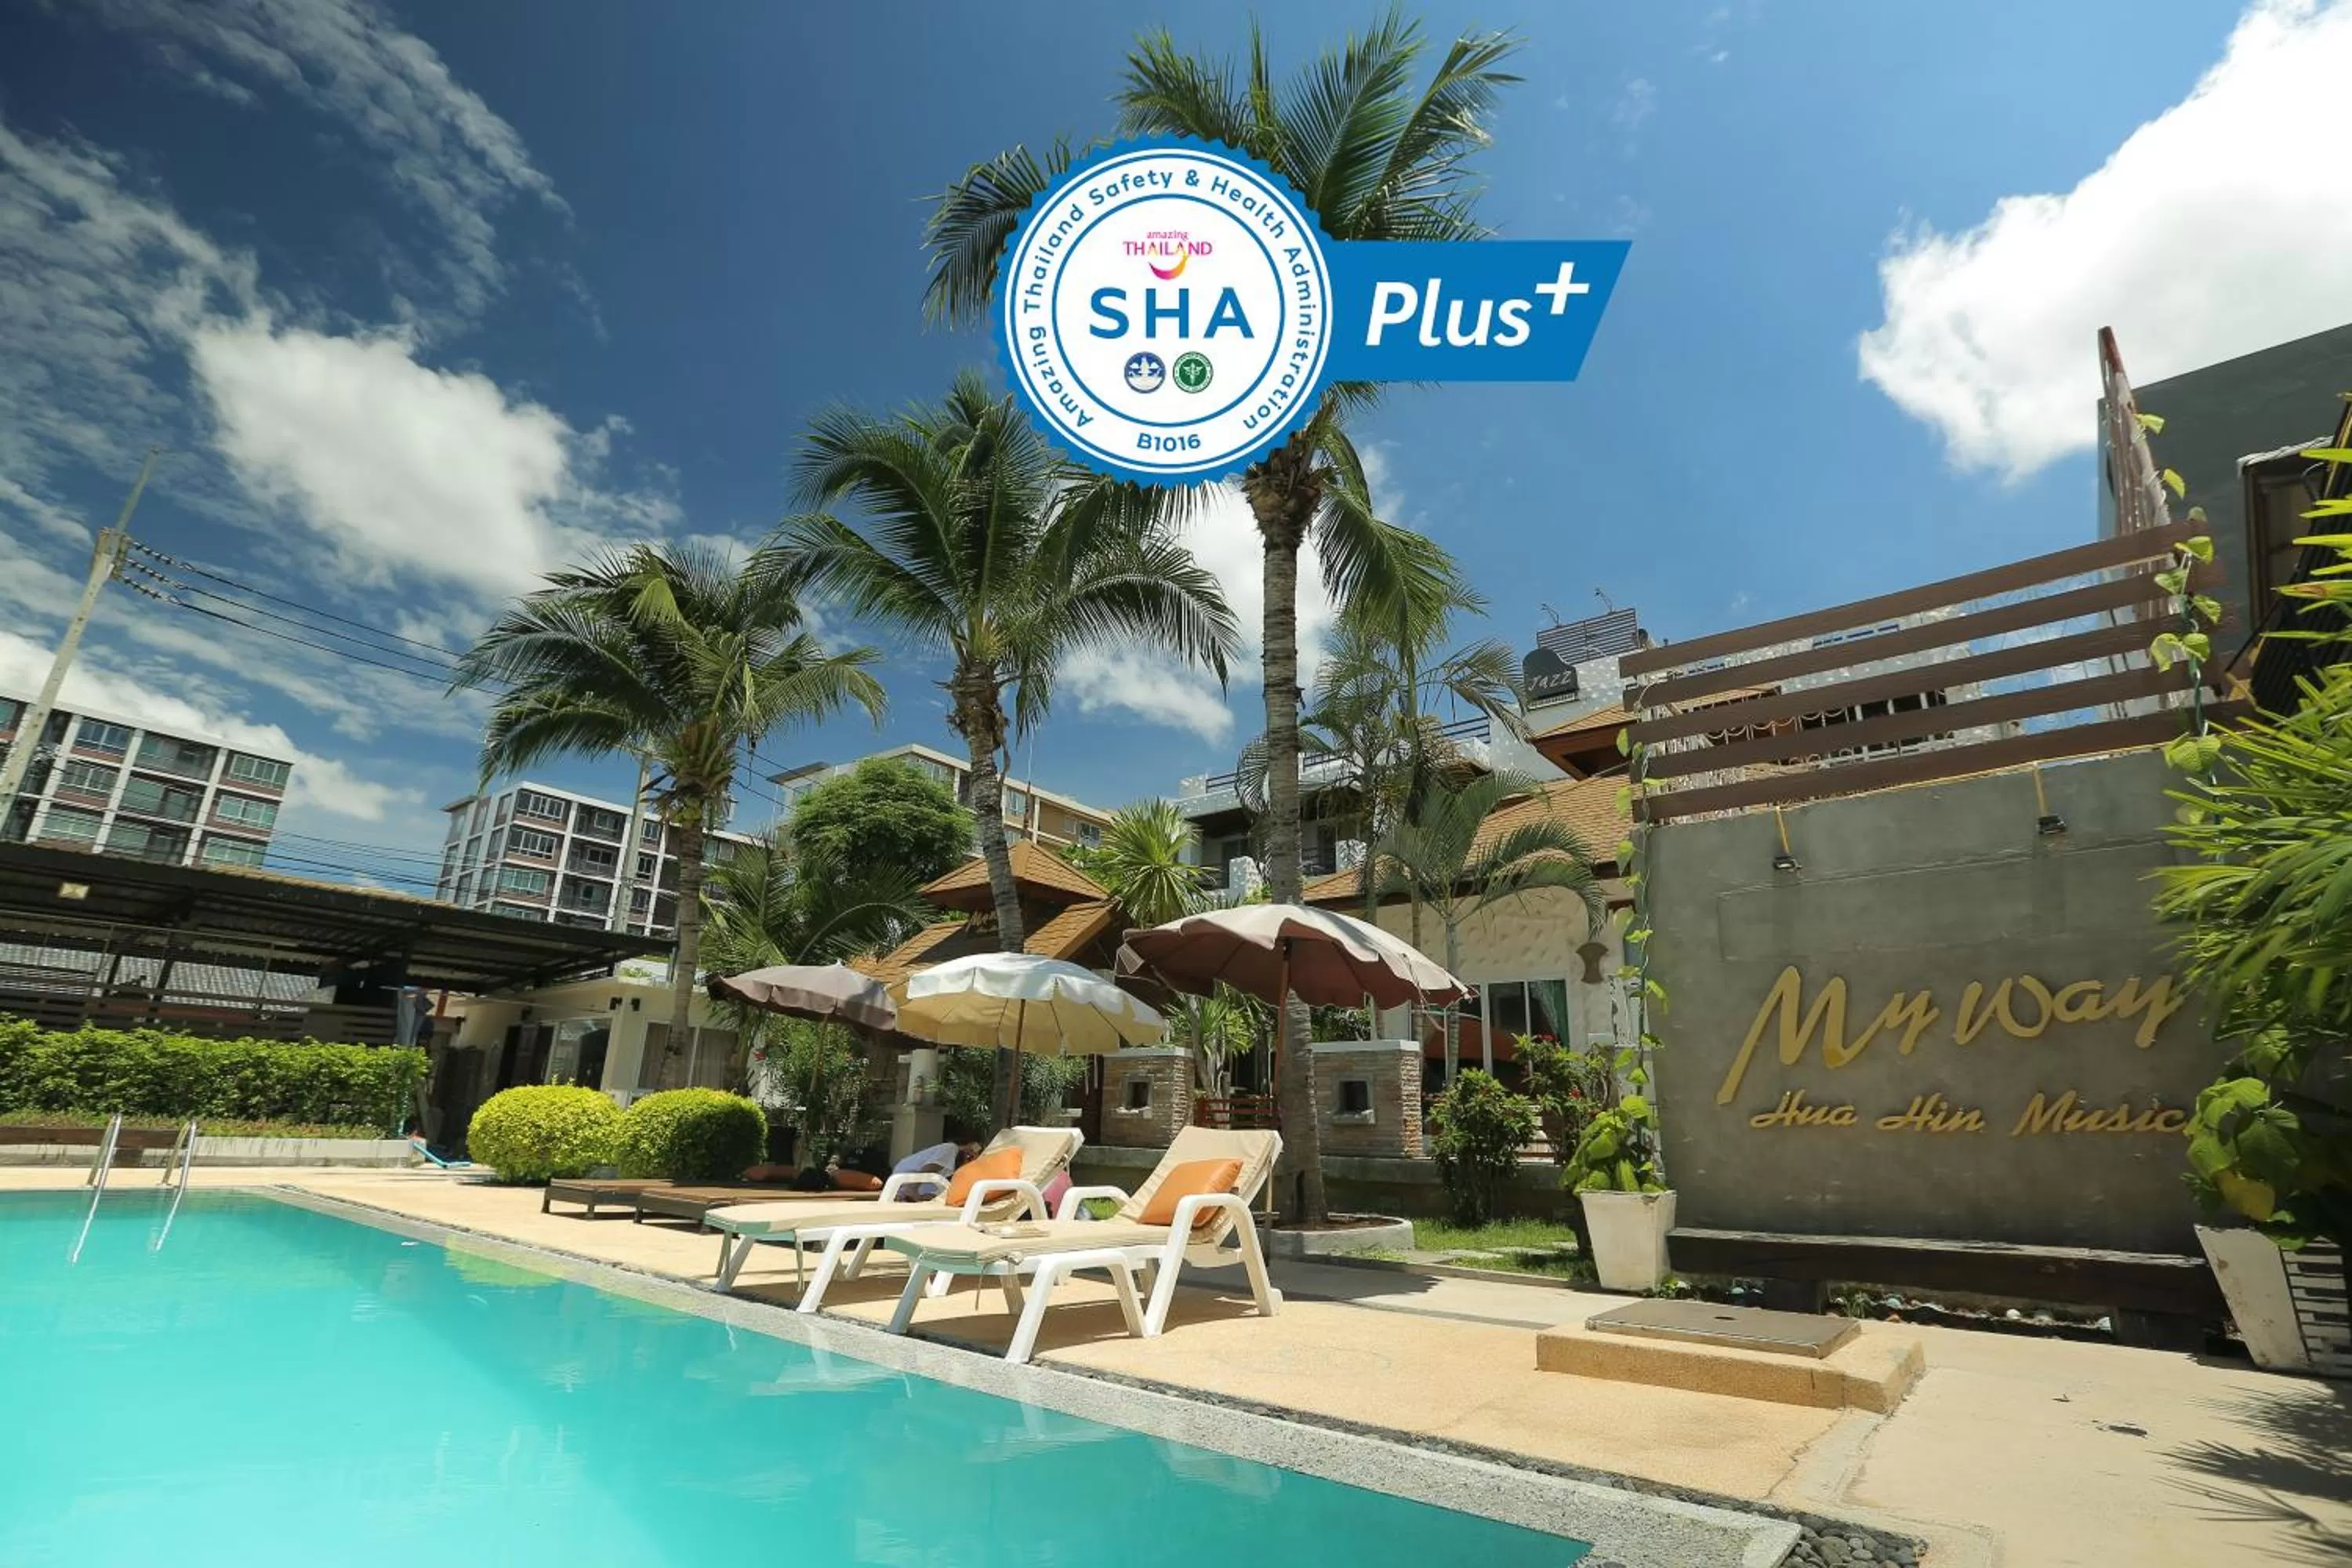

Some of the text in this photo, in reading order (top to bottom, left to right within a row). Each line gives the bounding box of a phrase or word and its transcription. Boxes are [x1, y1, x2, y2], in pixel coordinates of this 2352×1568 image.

[1717, 966, 2187, 1105] My Way
[1750, 1089, 2187, 1136] Hua Hin Music
